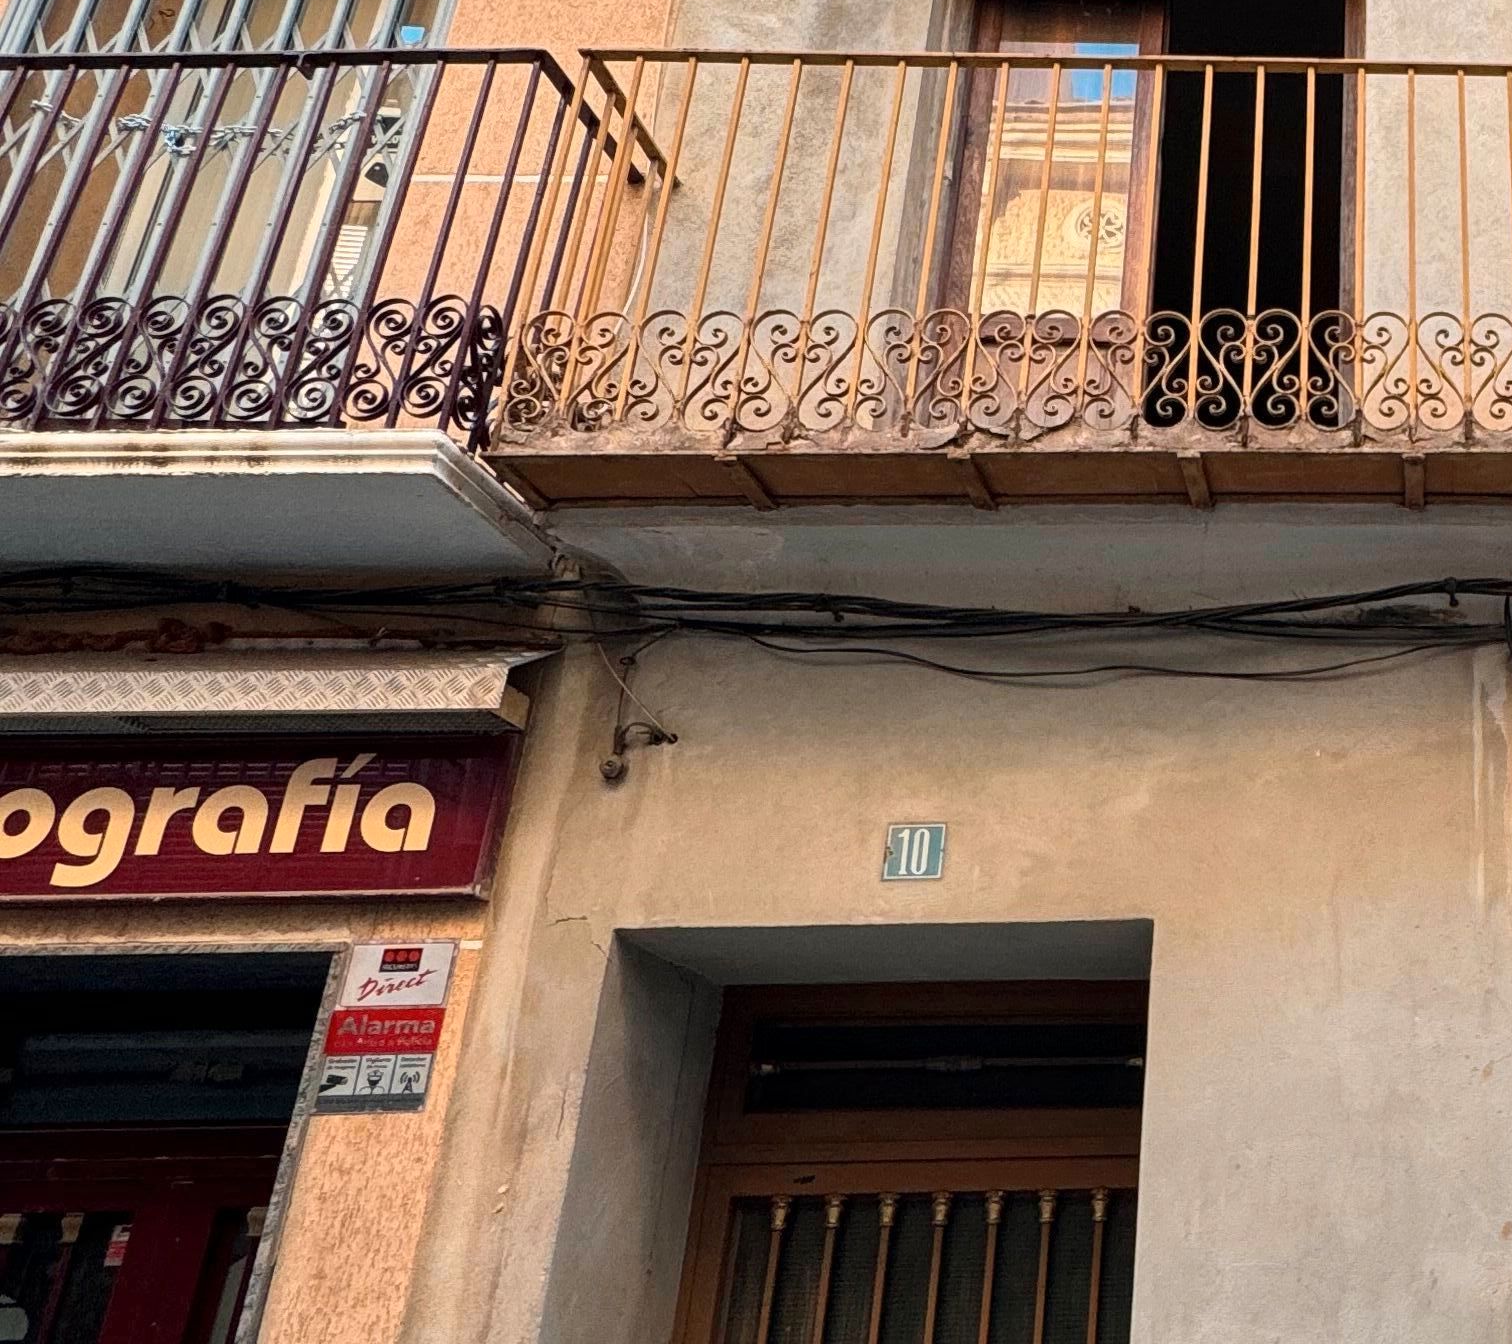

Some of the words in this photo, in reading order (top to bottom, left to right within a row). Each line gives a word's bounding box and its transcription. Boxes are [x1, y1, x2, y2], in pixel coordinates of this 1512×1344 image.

[0, 753, 436, 887] ografía
[898, 828, 930, 875] 10
[356, 968, 438, 1002] Direct
[335, 1014, 436, 1036] Alarma
